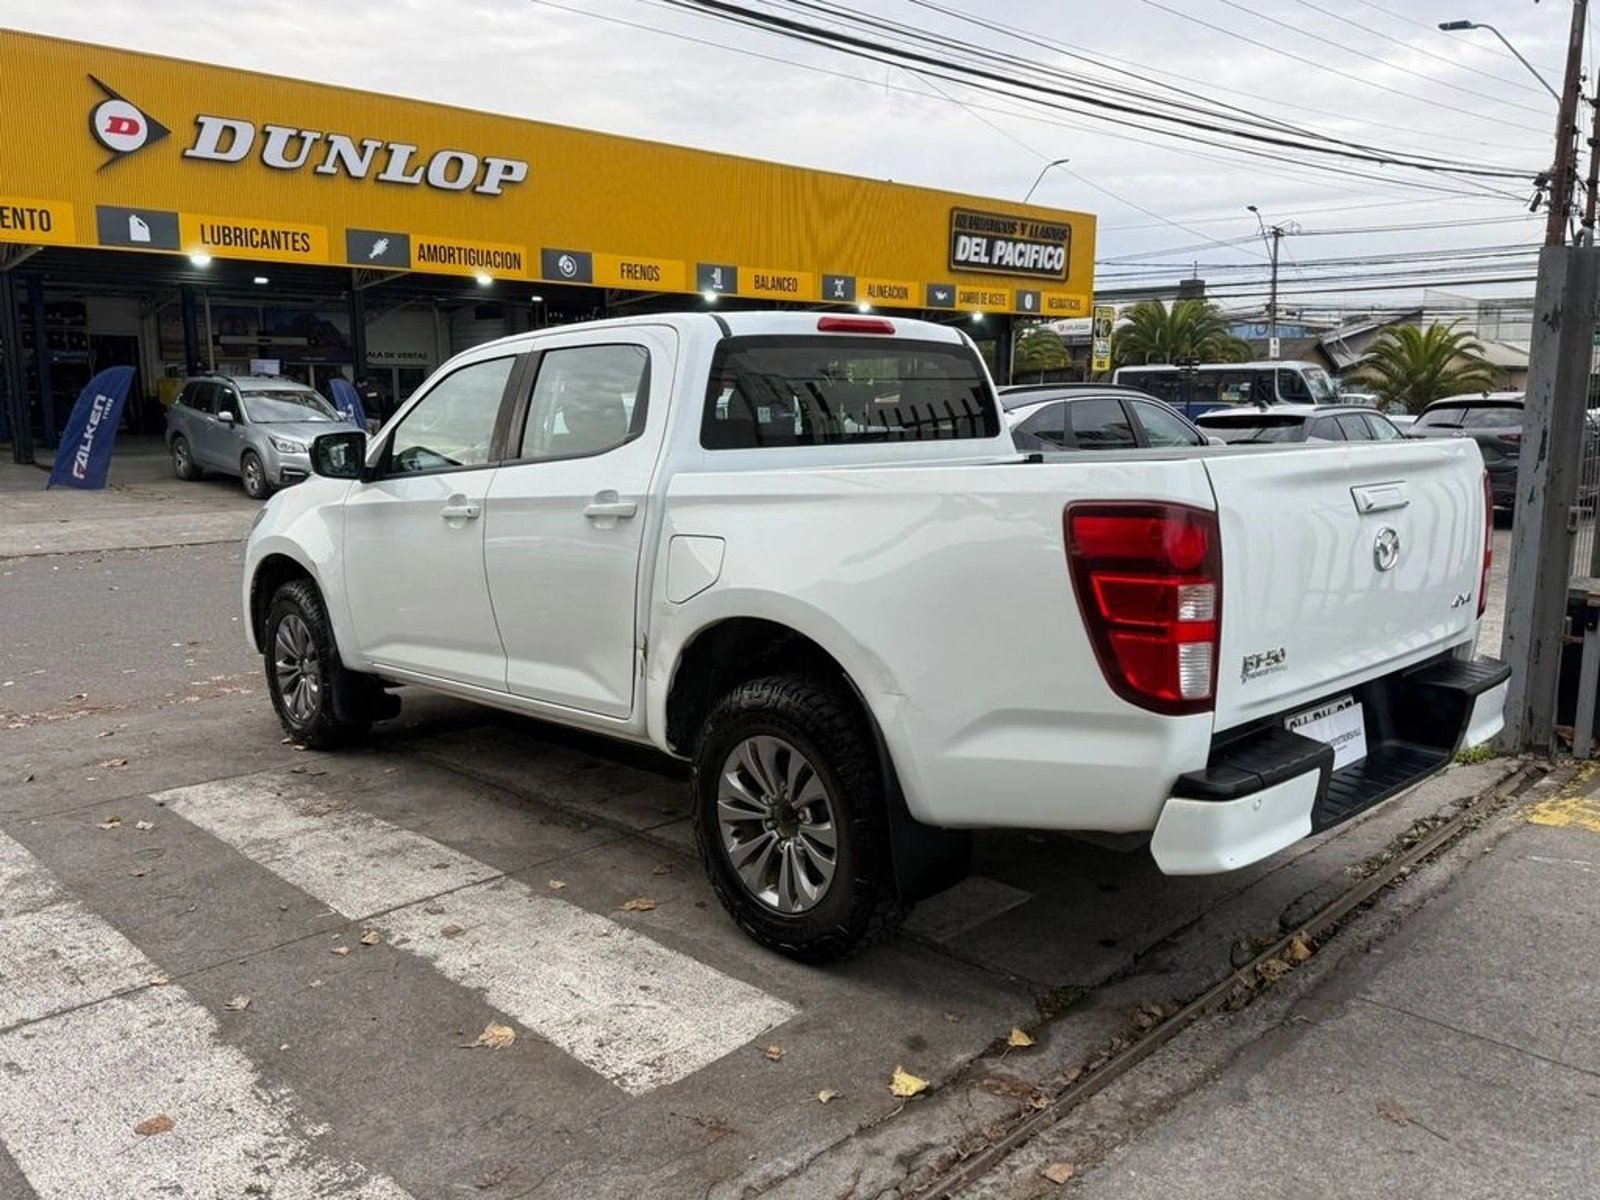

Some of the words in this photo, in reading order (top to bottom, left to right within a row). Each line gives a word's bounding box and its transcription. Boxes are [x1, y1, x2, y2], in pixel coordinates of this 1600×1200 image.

[184, 114, 529, 195] DUNLOP
[0, 206, 52, 233] ENTO
[200, 223, 311, 253] LUBRICANTES
[417, 243, 522, 270] AMORTIGUACION
[954, 235, 990, 264] DEL
[992, 239, 1066, 271] PACIFICO
[620, 262, 661, 282] FRENOS
[753, 274, 798, 292] BALANCEO
[867, 283, 909, 300] ALINEACION
[72, 394, 107, 480] FALKEN
